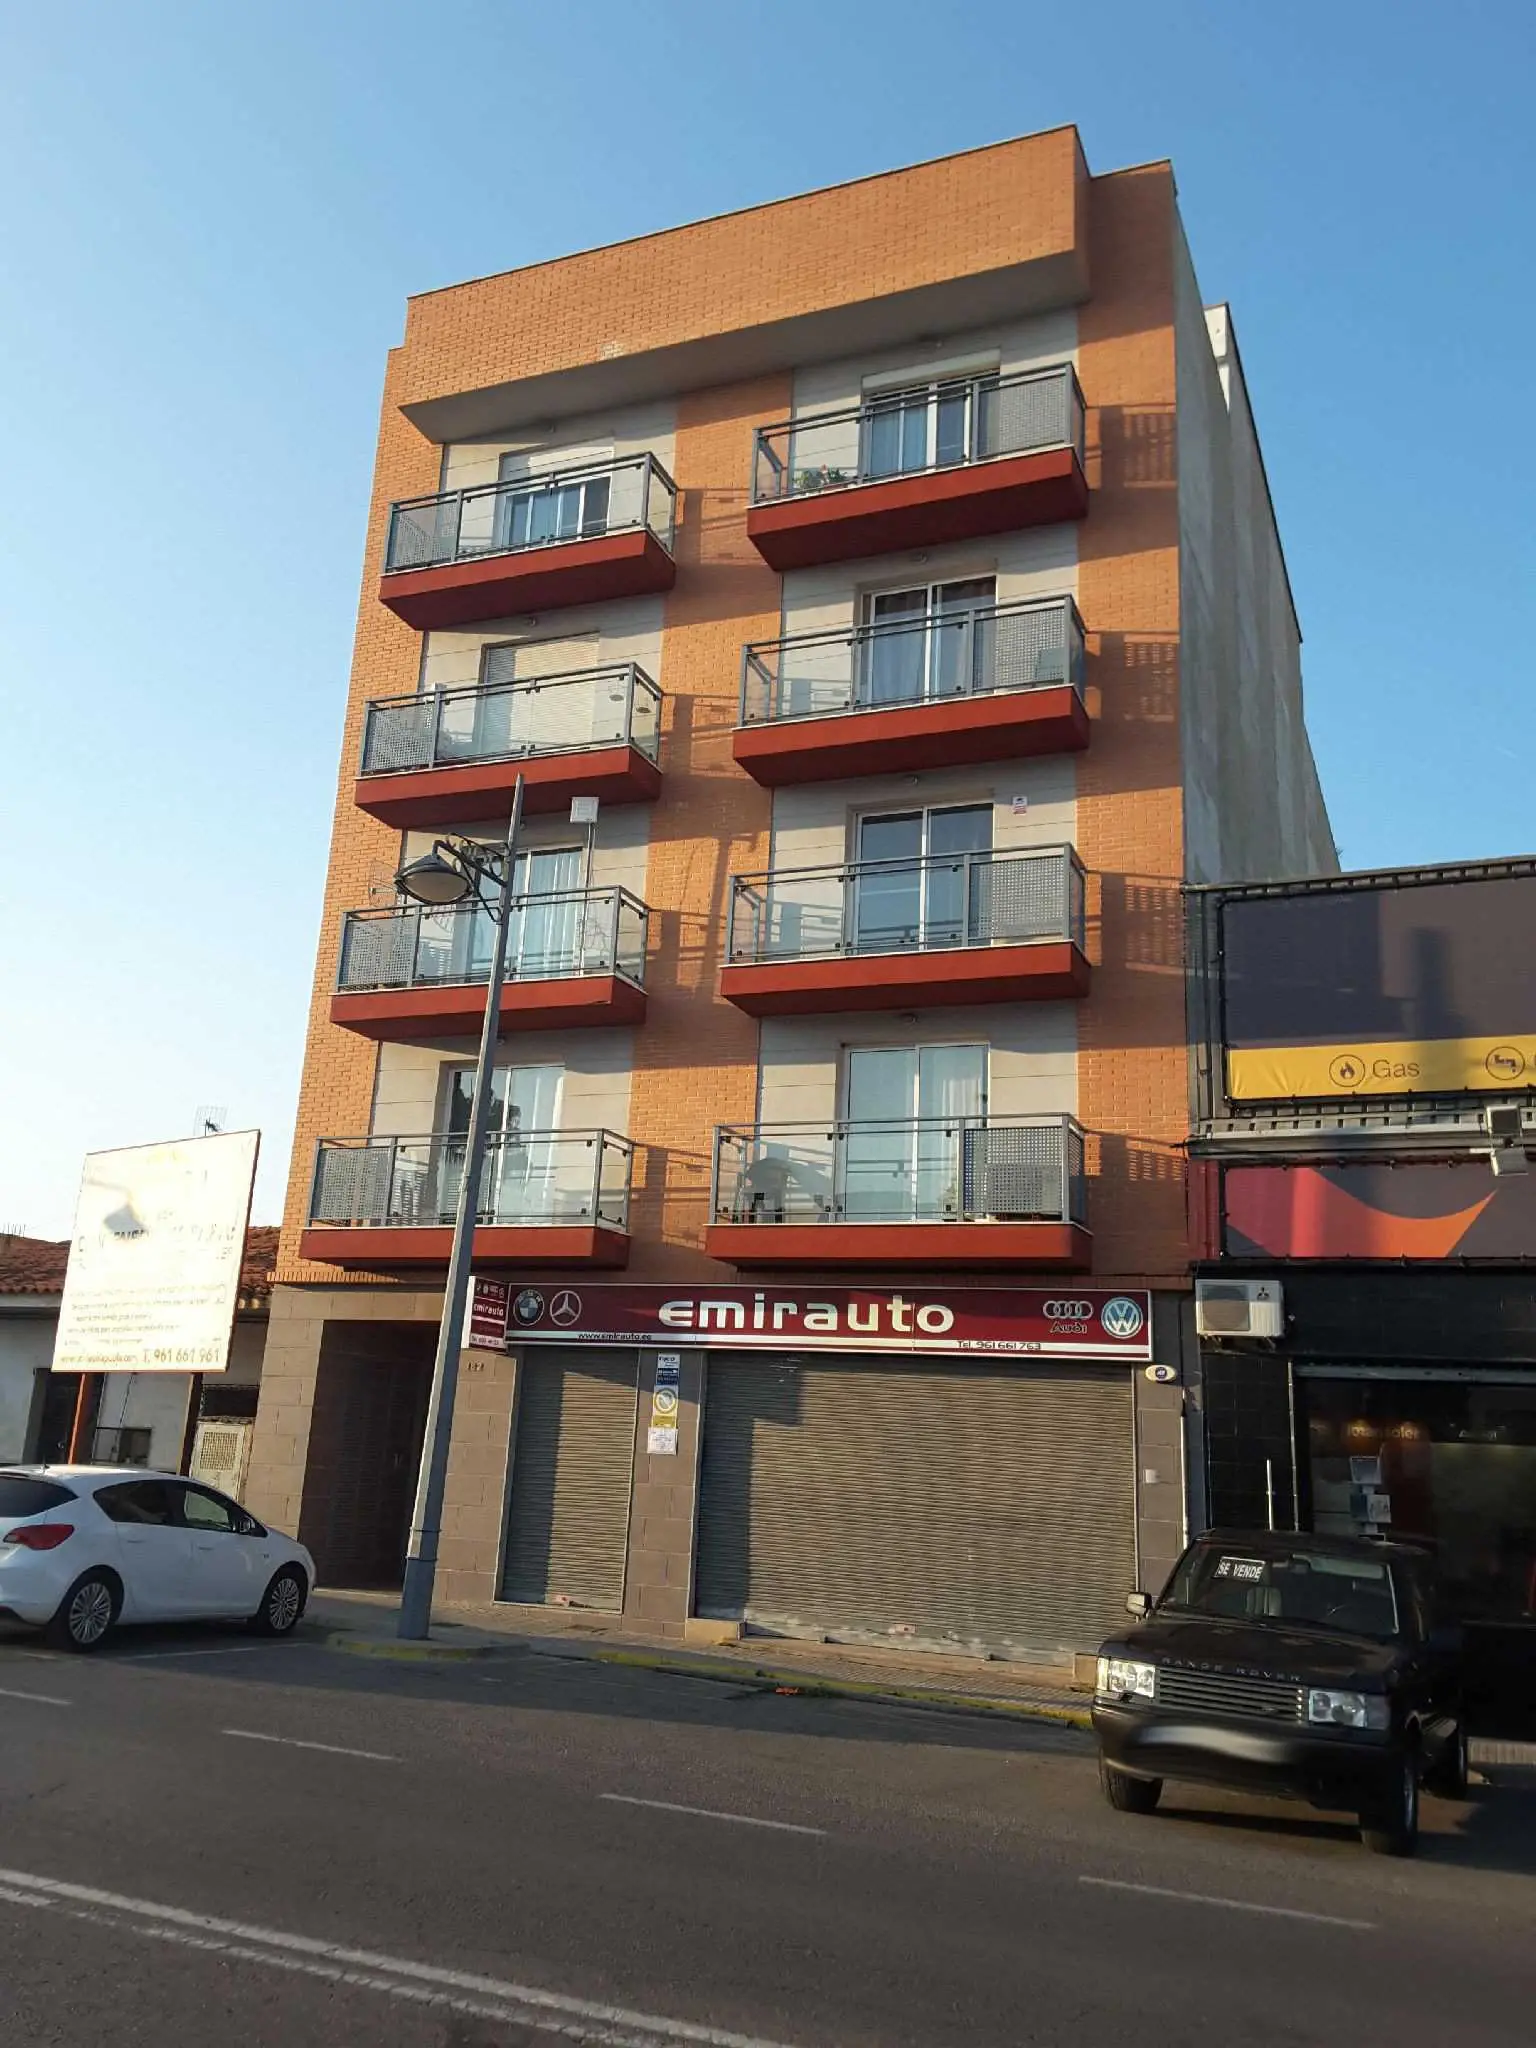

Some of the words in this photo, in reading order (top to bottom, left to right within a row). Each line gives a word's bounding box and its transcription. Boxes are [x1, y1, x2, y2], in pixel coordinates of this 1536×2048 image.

[1372, 1058, 1420, 1078] Gas
[473, 1303, 504, 1316] emirauto
[657, 1292, 955, 1334] emirauto
[1049, 1320, 1088, 1334] Audi
[976, 1341, 995, 1349] 961
[998, 1342, 1017, 1350] 661
[1019, 1342, 1041, 1350] 763
[154, 1347, 172, 1363] 961
[199, 1347, 220, 1363] 961
[1217, 1561, 1231, 1575] SE
[1232, 1563, 1263, 1579] VENDE
[1161, 1656, 1224, 1672] RANGE
